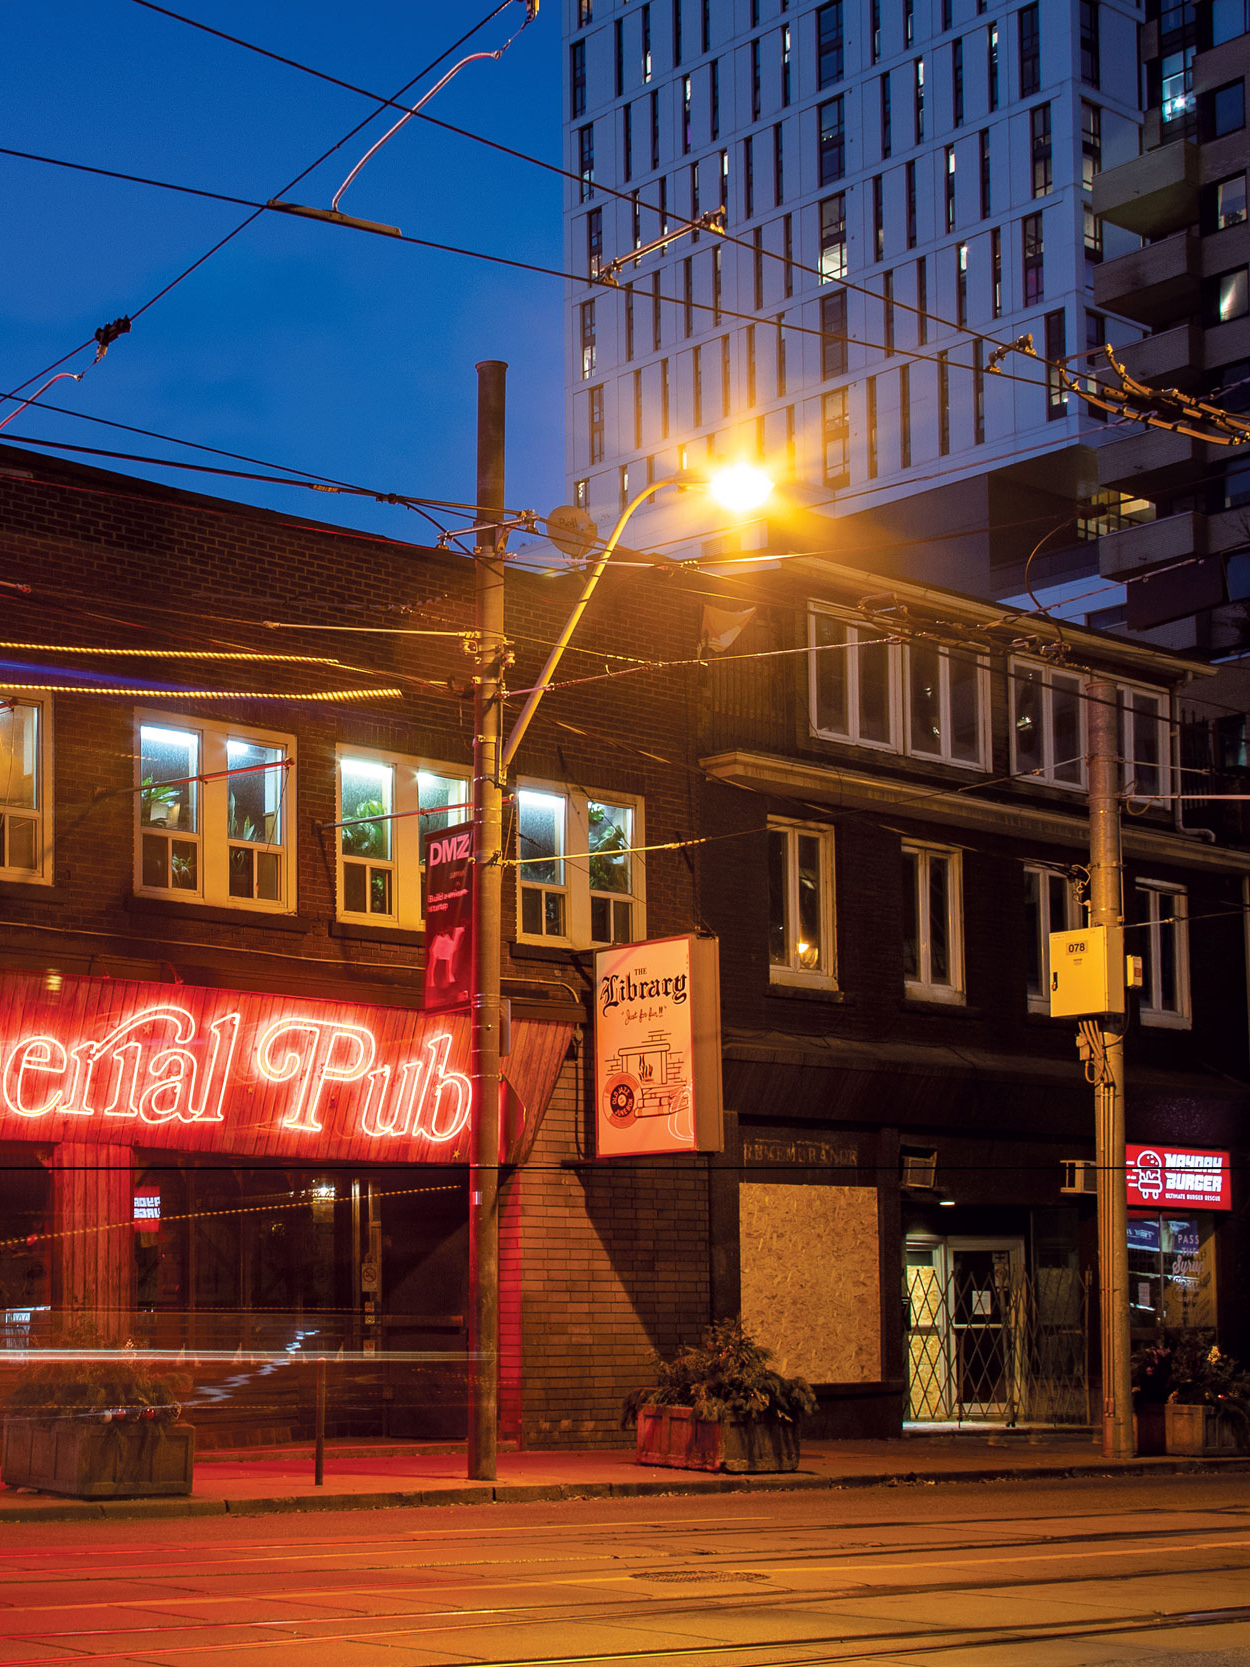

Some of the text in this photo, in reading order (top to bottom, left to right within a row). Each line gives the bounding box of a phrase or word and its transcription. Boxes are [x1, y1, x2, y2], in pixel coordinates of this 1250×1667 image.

[430, 833, 470, 867] DMZ
[1068, 942, 1085, 953] 078
[634, 967, 647, 976] THE
[600, 973, 688, 1018] Library
[256, 1017, 472, 1142] Pub
[1164, 1153, 1222, 1173] MAYDAY
[1165, 1172, 1222, 1192] BURGER
[1177, 1234, 1200, 1245] PASS
[1172, 1254, 1205, 1277] Syrup
